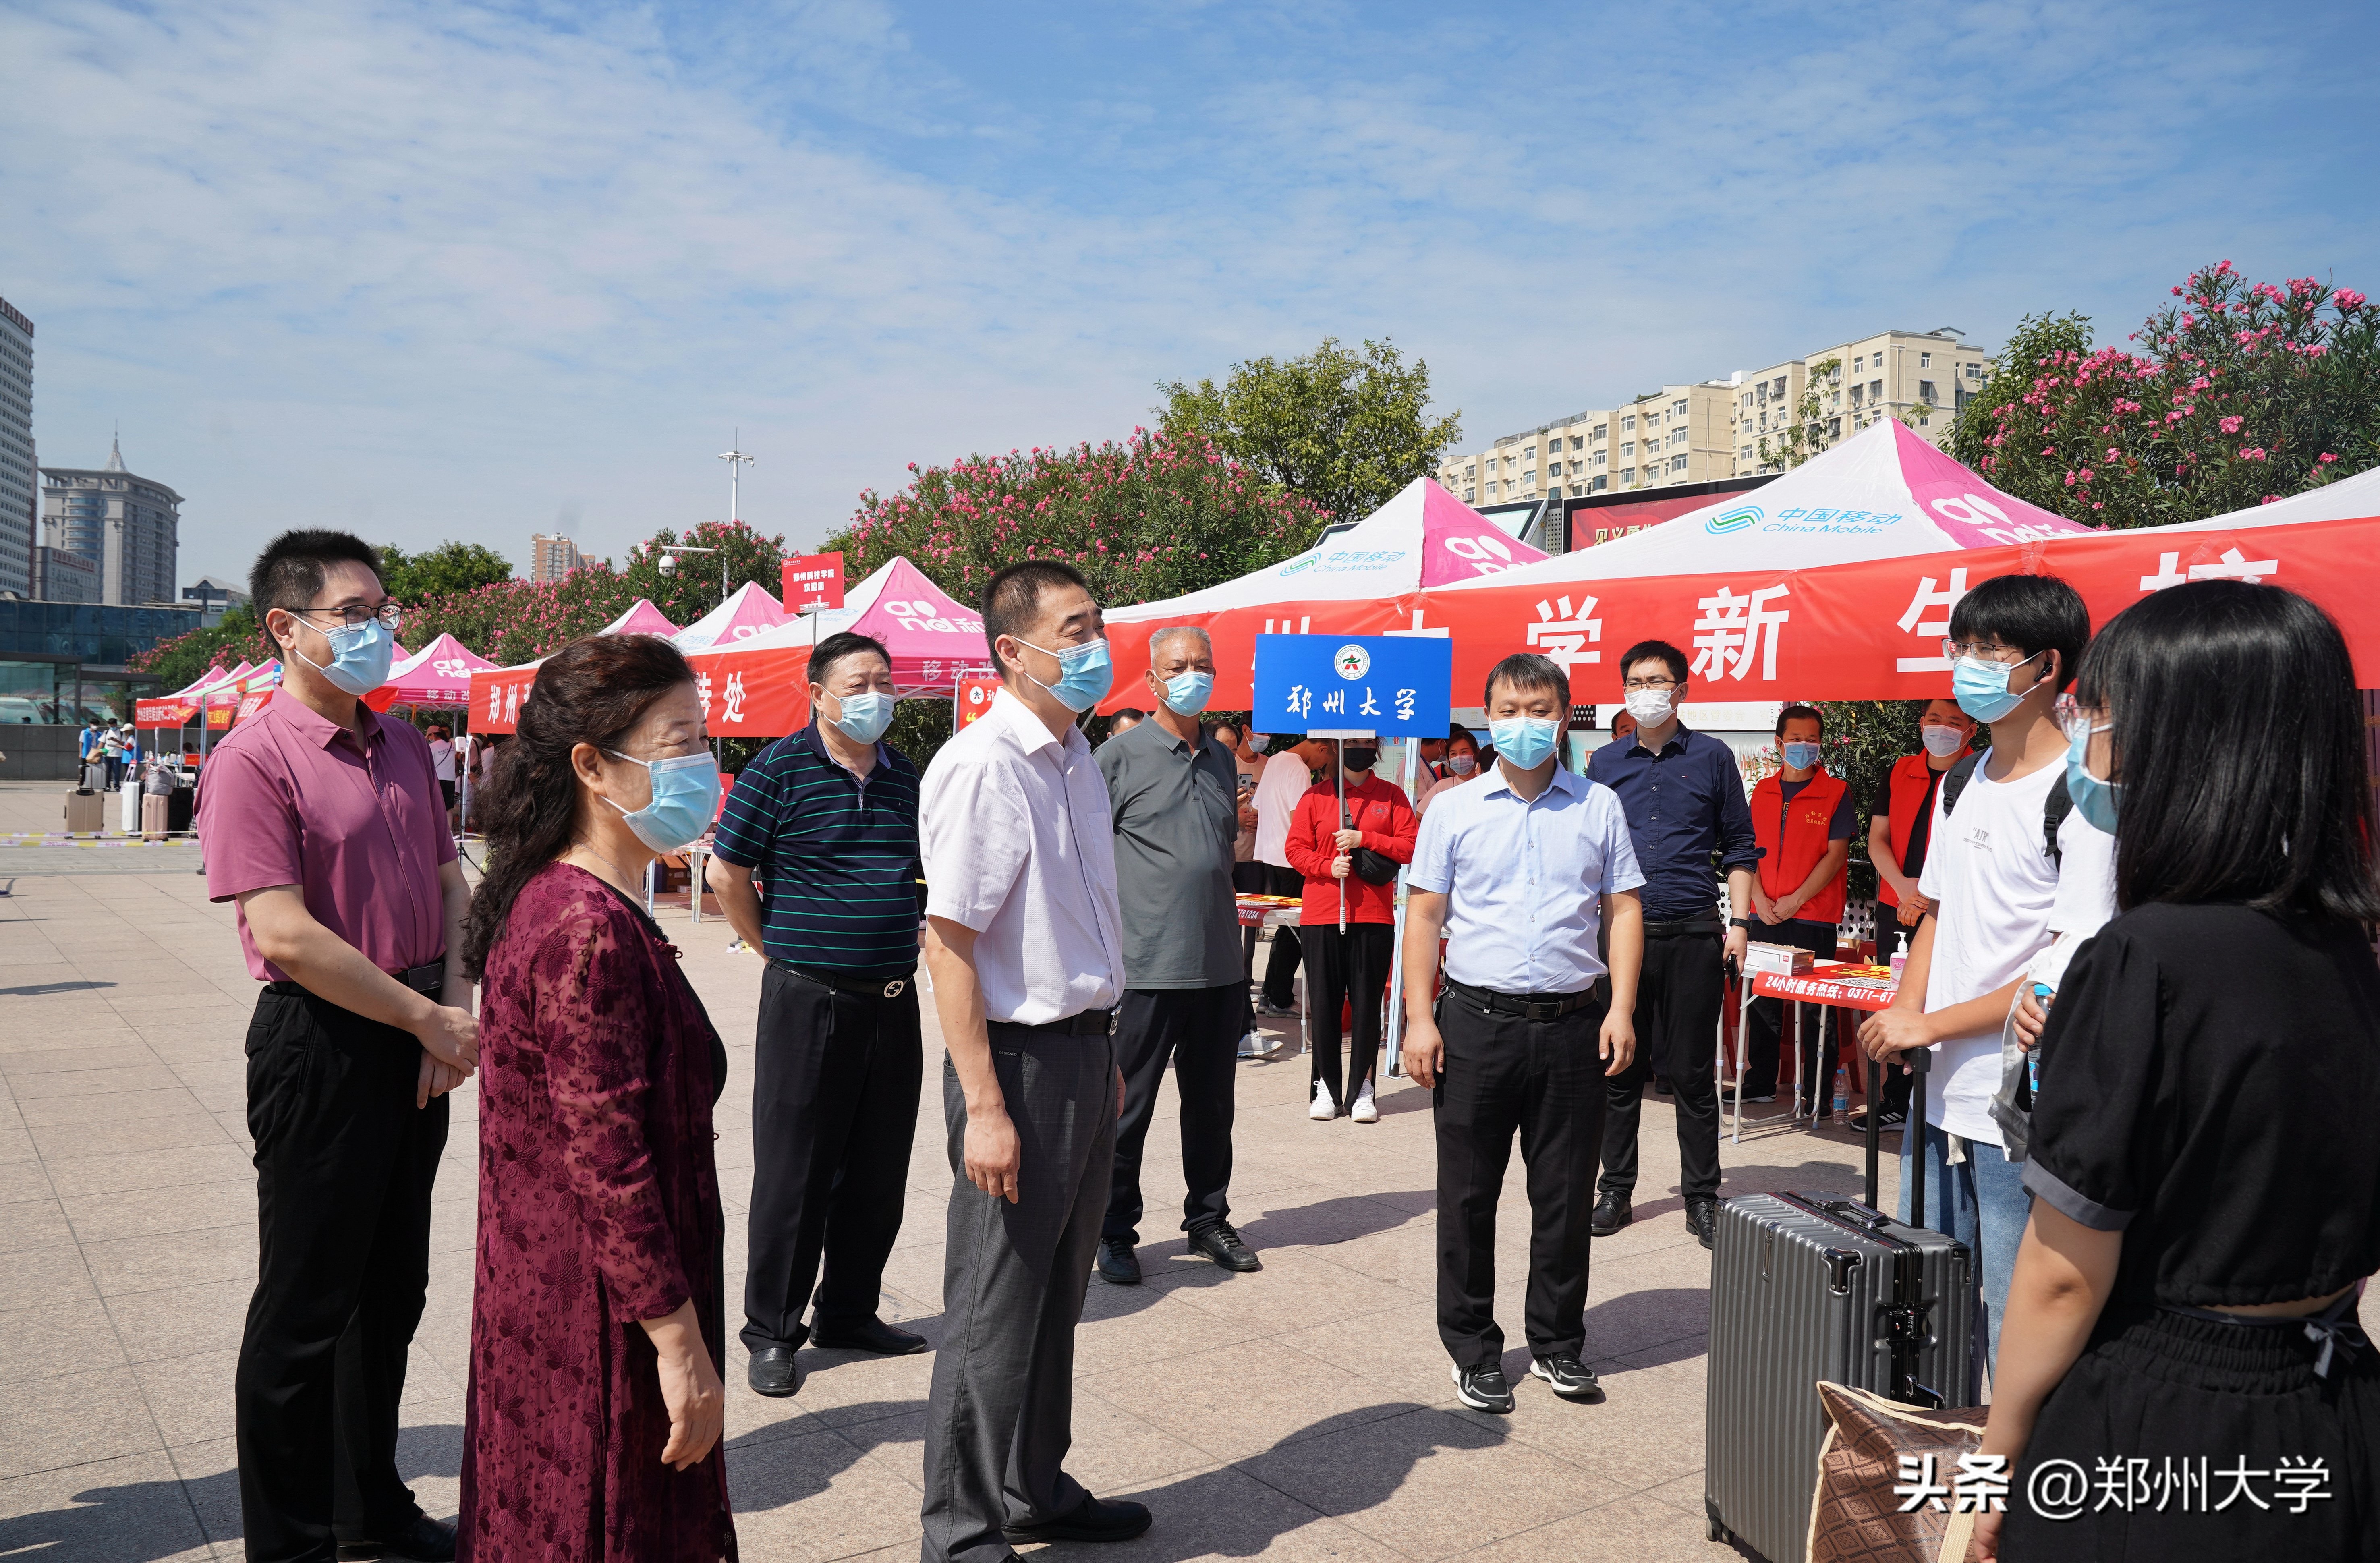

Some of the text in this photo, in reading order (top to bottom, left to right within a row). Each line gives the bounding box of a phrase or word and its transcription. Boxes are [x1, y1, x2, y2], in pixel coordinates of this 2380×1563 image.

[1777, 507, 1903, 525] 中国移动
[1593, 523, 1652, 546] 见义勇
[1763, 524, 1883, 533] China Mobile
[1328, 550, 1407, 563] 中国移动
[1348, 563, 1388, 571] Mobile
[793, 568, 835, 582] 郑州科技学院
[803, 581, 825, 592] 欢迎您
[1353, 647, 1367, 667] UNIVERSITY
[1286, 684, 1416, 721] 郑州大学
[1847, 987, 1897, 1003] 0371-67
